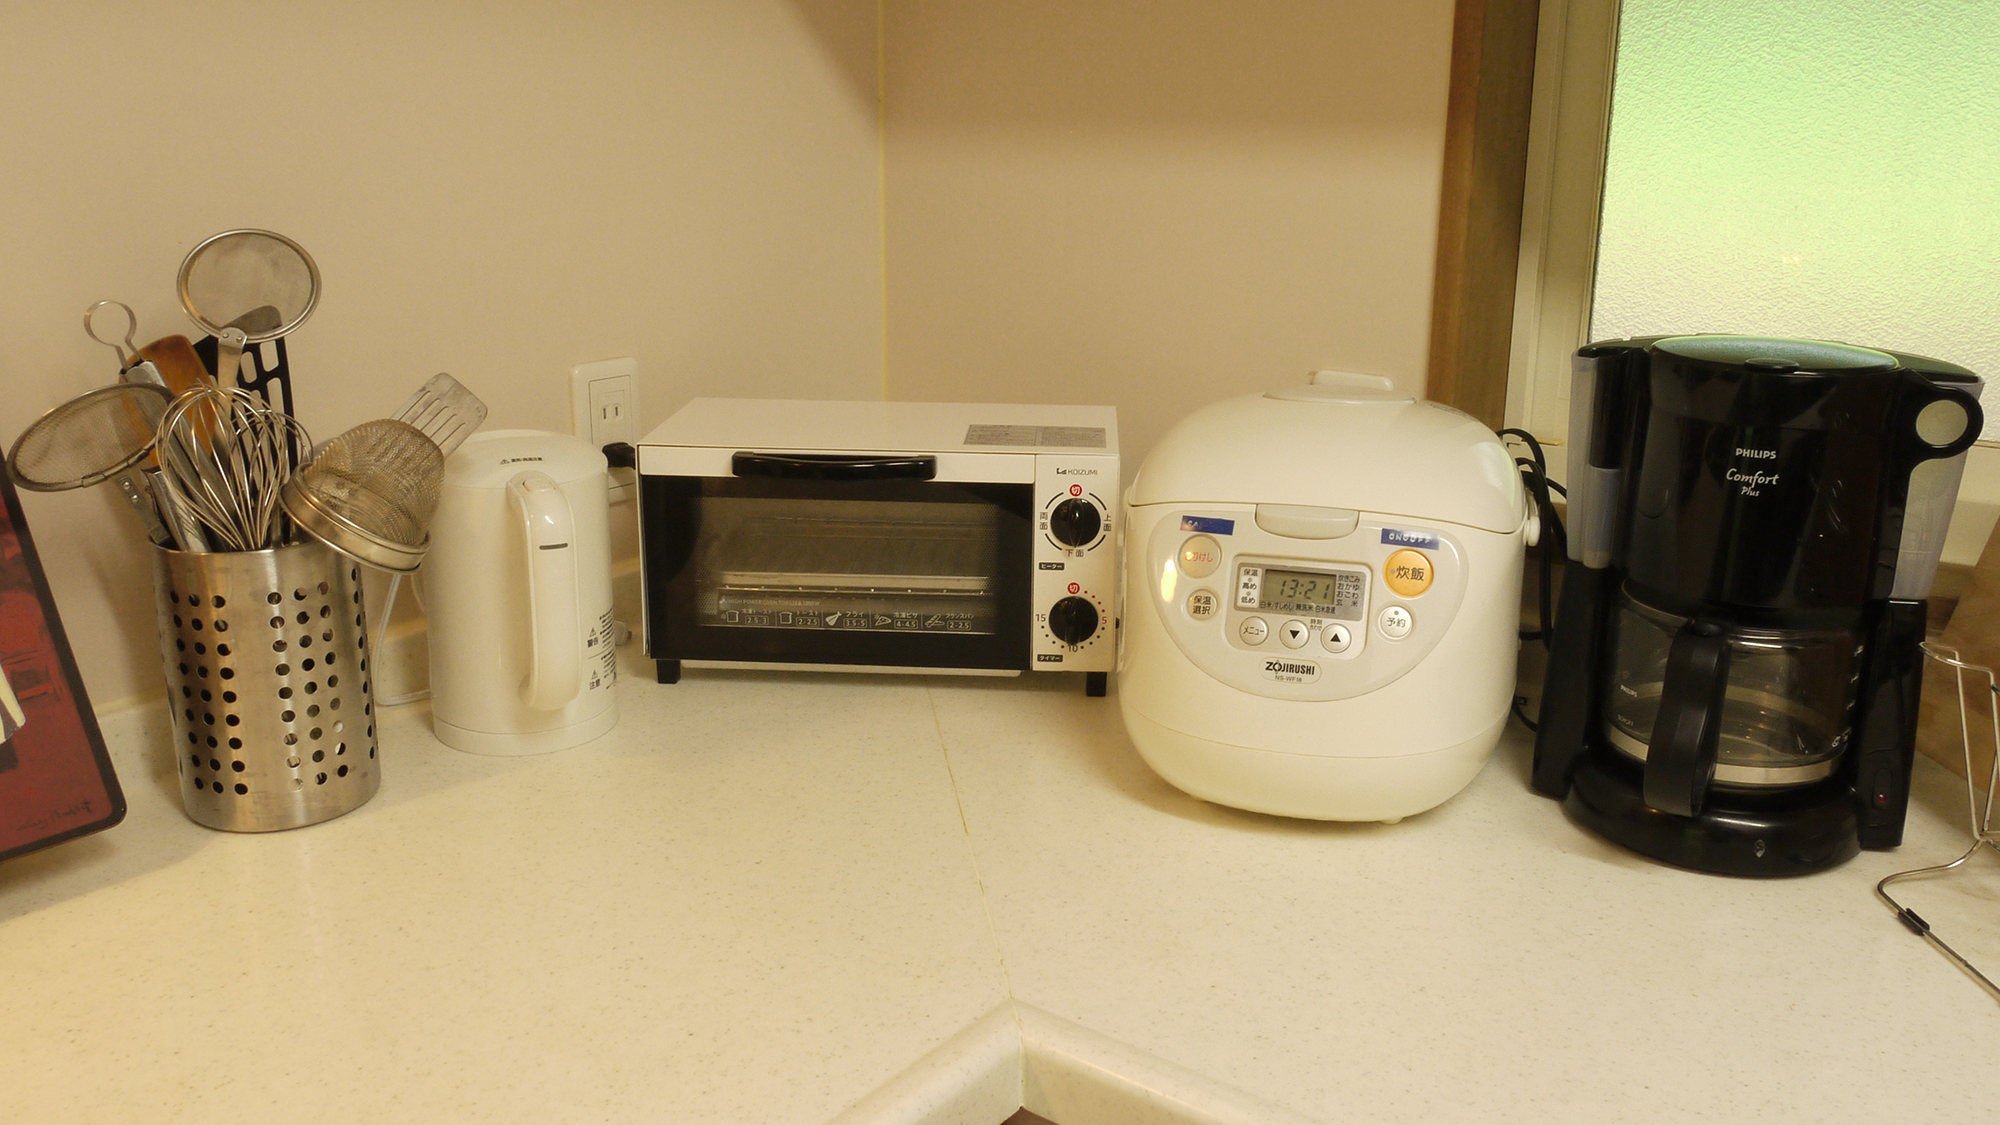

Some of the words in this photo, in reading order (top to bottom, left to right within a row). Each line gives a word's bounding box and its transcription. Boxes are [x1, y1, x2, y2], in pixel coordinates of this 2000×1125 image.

[1735, 447, 1777, 459] PHILIPS
[1067, 468, 1098, 476] KOIZUMI
[1726, 467, 1780, 488] Comfort
[1070, 485, 1081, 496] 切
[1740, 486, 1760, 497] Plus
[1102, 513, 1112, 532] 上面
[1065, 549, 1084, 558] 下面
[1243, 568, 1259, 577] 保温
[1395, 565, 1425, 582] 炊飯
[1068, 583, 1080, 593] 切
[1241, 582, 1257, 591] 高め
[1279, 578, 1331, 600] 13:21
[1193, 595, 1212, 605] 保温
[1240, 596, 1256, 605] 低め
[1192, 606, 1212, 616] 選択
[1035, 614, 1046, 622] 15
[1101, 616, 1107, 625] 5
[1387, 617, 1406, 628] 予約
[1243, 626, 1265, 636] メニュー
[1067, 644, 1078, 653] 10
[1265, 660, 1315, 676] ZOJIRUSHI
